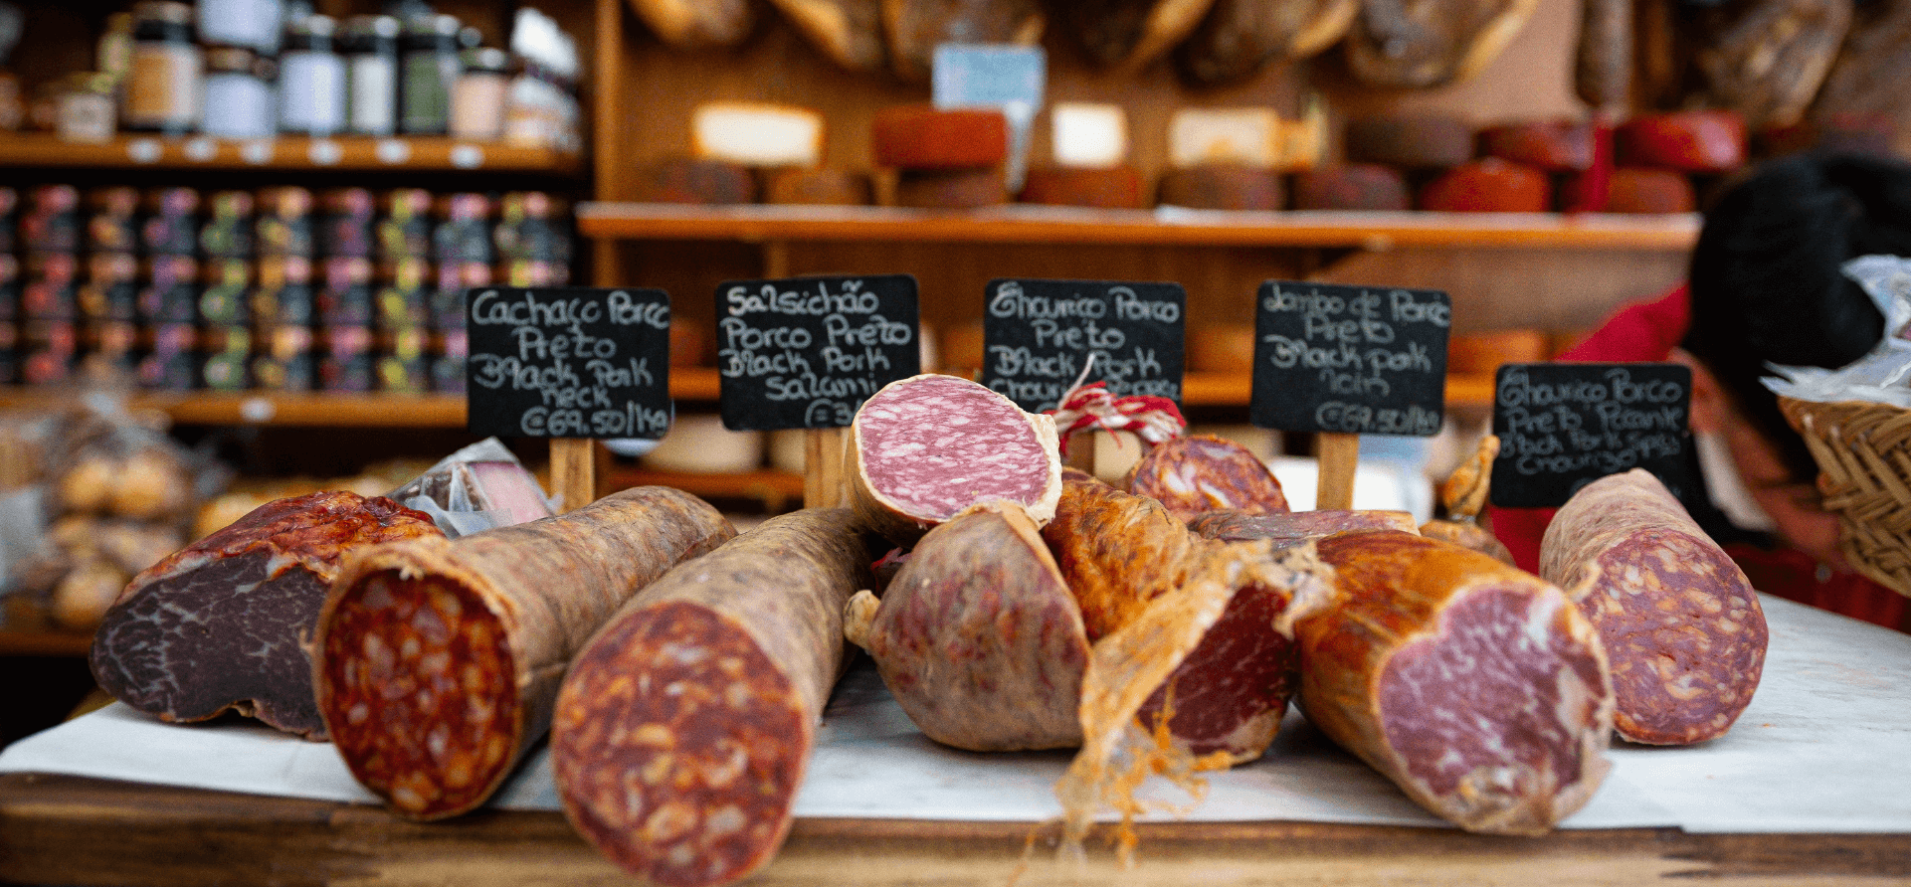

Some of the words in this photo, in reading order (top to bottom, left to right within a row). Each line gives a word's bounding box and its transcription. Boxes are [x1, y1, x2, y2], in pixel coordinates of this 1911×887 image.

[727, 280, 880, 316] Salsichão
[1108, 286, 1180, 323] Porco
[511, 325, 616, 361] Preto
[720, 316, 812, 349] Porco
[822, 313, 912, 346] Preto
[1030, 319, 1126, 349] Preto
[1304, 311, 1395, 343] Preto
[718, 348, 811, 377] Black
[820, 346, 891, 374] Pork
[989, 345, 1076, 377] Black
[1093, 346, 1162, 377] Pork
[1262, 334, 1363, 370] Black
[470, 353, 580, 389] Black
[585, 357, 653, 387] Pork
[1603, 367, 1683, 403] Porco
